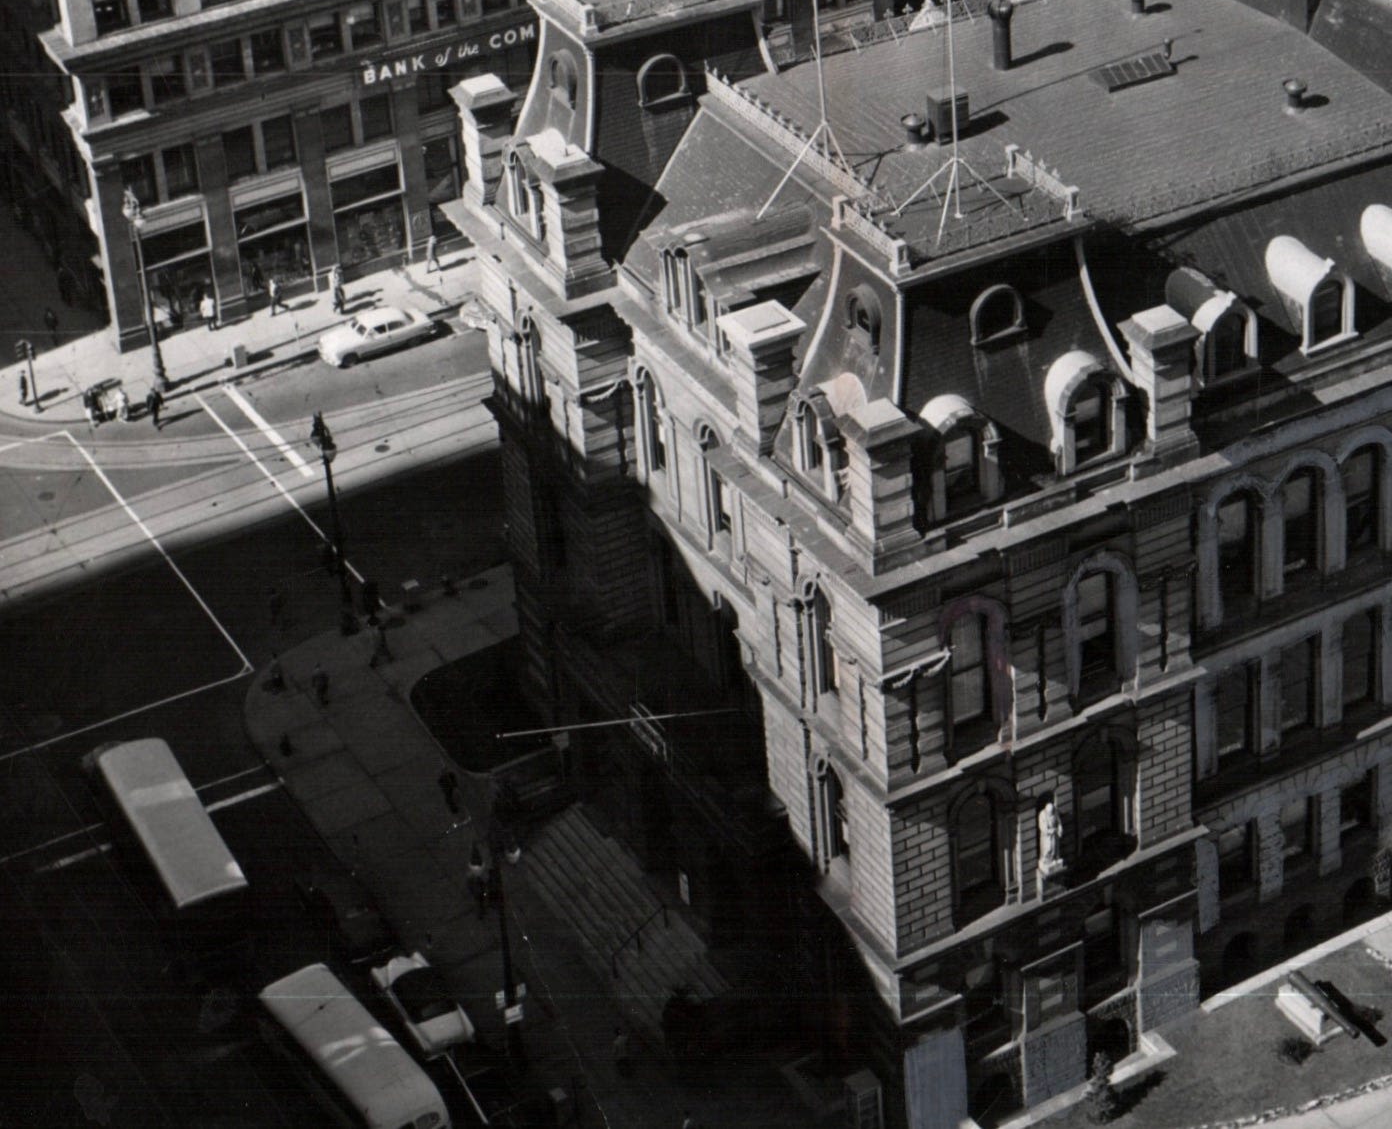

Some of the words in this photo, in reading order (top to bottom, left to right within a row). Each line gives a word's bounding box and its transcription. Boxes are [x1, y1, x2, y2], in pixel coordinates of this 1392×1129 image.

[363, 54, 426, 84] BANK
[434, 46, 452, 67] of
[457, 41, 480, 58] the
